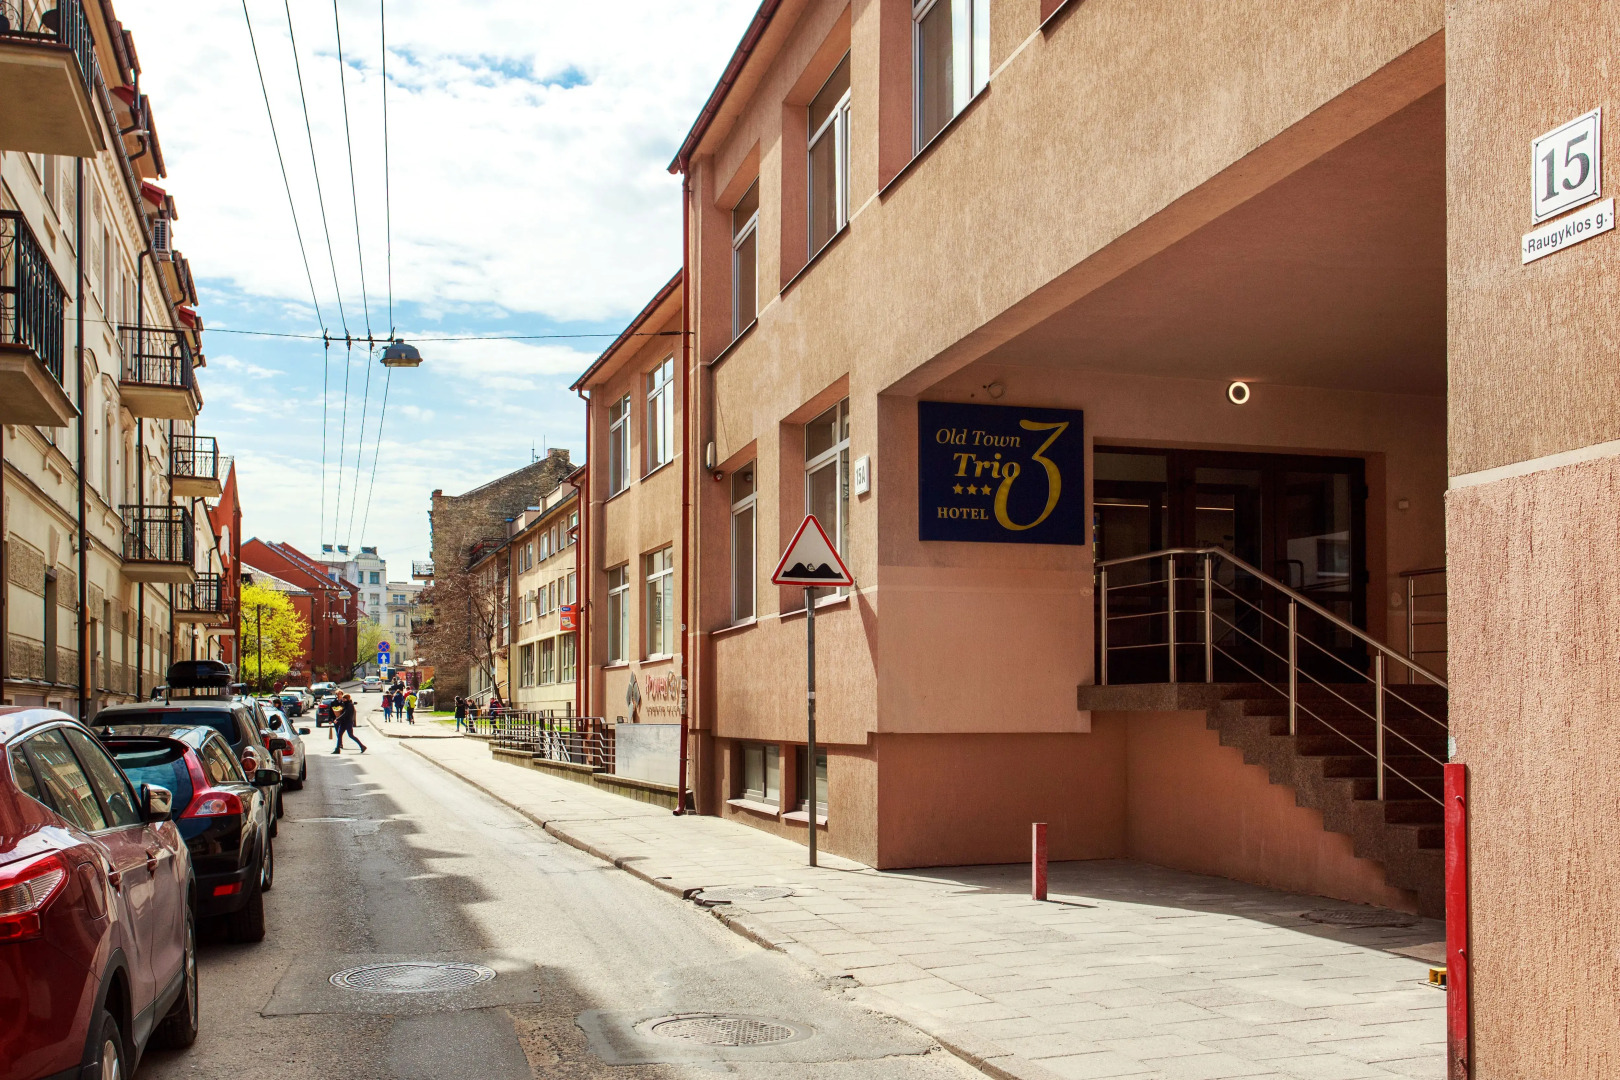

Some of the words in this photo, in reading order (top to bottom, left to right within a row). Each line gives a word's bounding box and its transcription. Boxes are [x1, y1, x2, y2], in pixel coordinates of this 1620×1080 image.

[1541, 130, 1591, 203] 15
[1527, 217, 1592, 254] Raugyklos
[1595, 212, 1608, 229] g.
[935, 428, 968, 445] Old
[972, 430, 1021, 448] Town
[953, 452, 1021, 479] Trio
[937, 506, 989, 520] HOTEL
